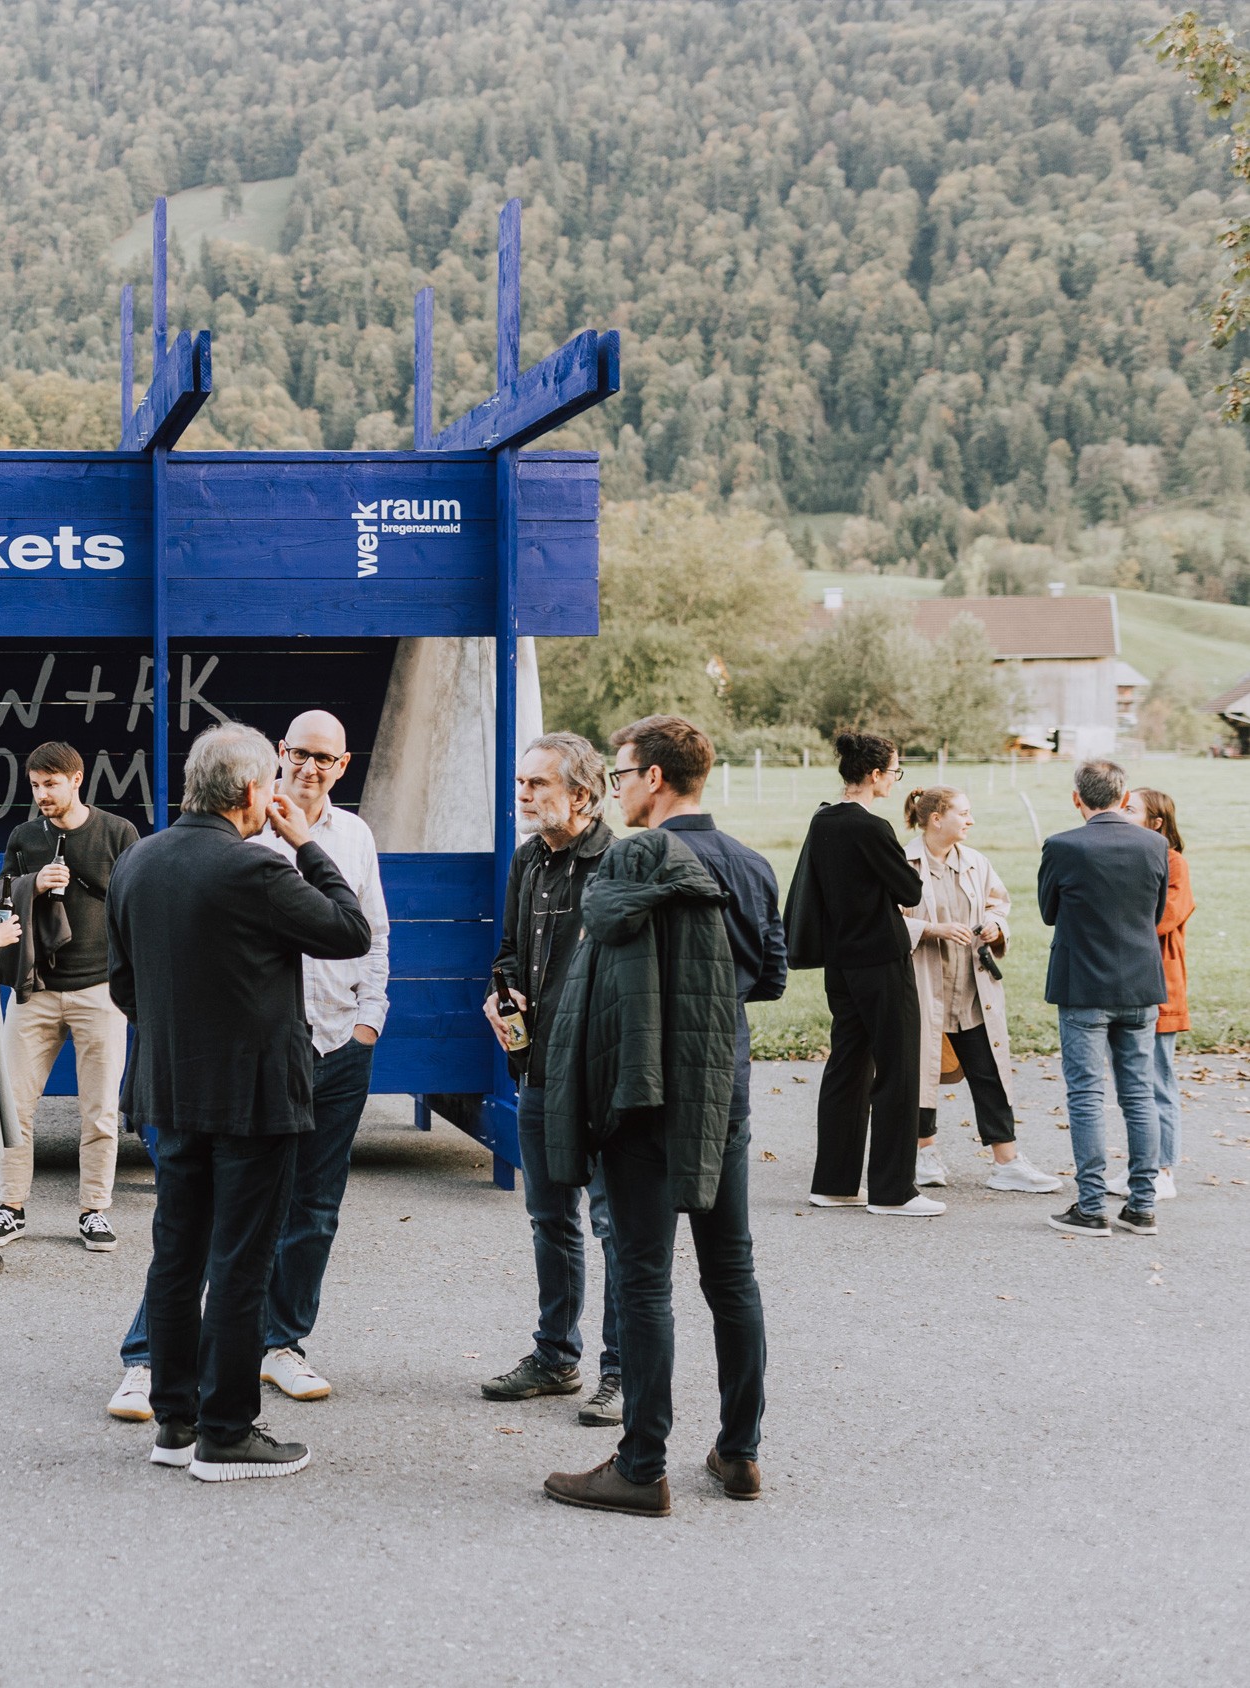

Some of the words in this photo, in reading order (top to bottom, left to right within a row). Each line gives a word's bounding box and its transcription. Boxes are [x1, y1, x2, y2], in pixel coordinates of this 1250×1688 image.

[381, 499, 461, 520] raum
[351, 501, 378, 578] werk
[381, 523, 461, 535] bregenzerwald
